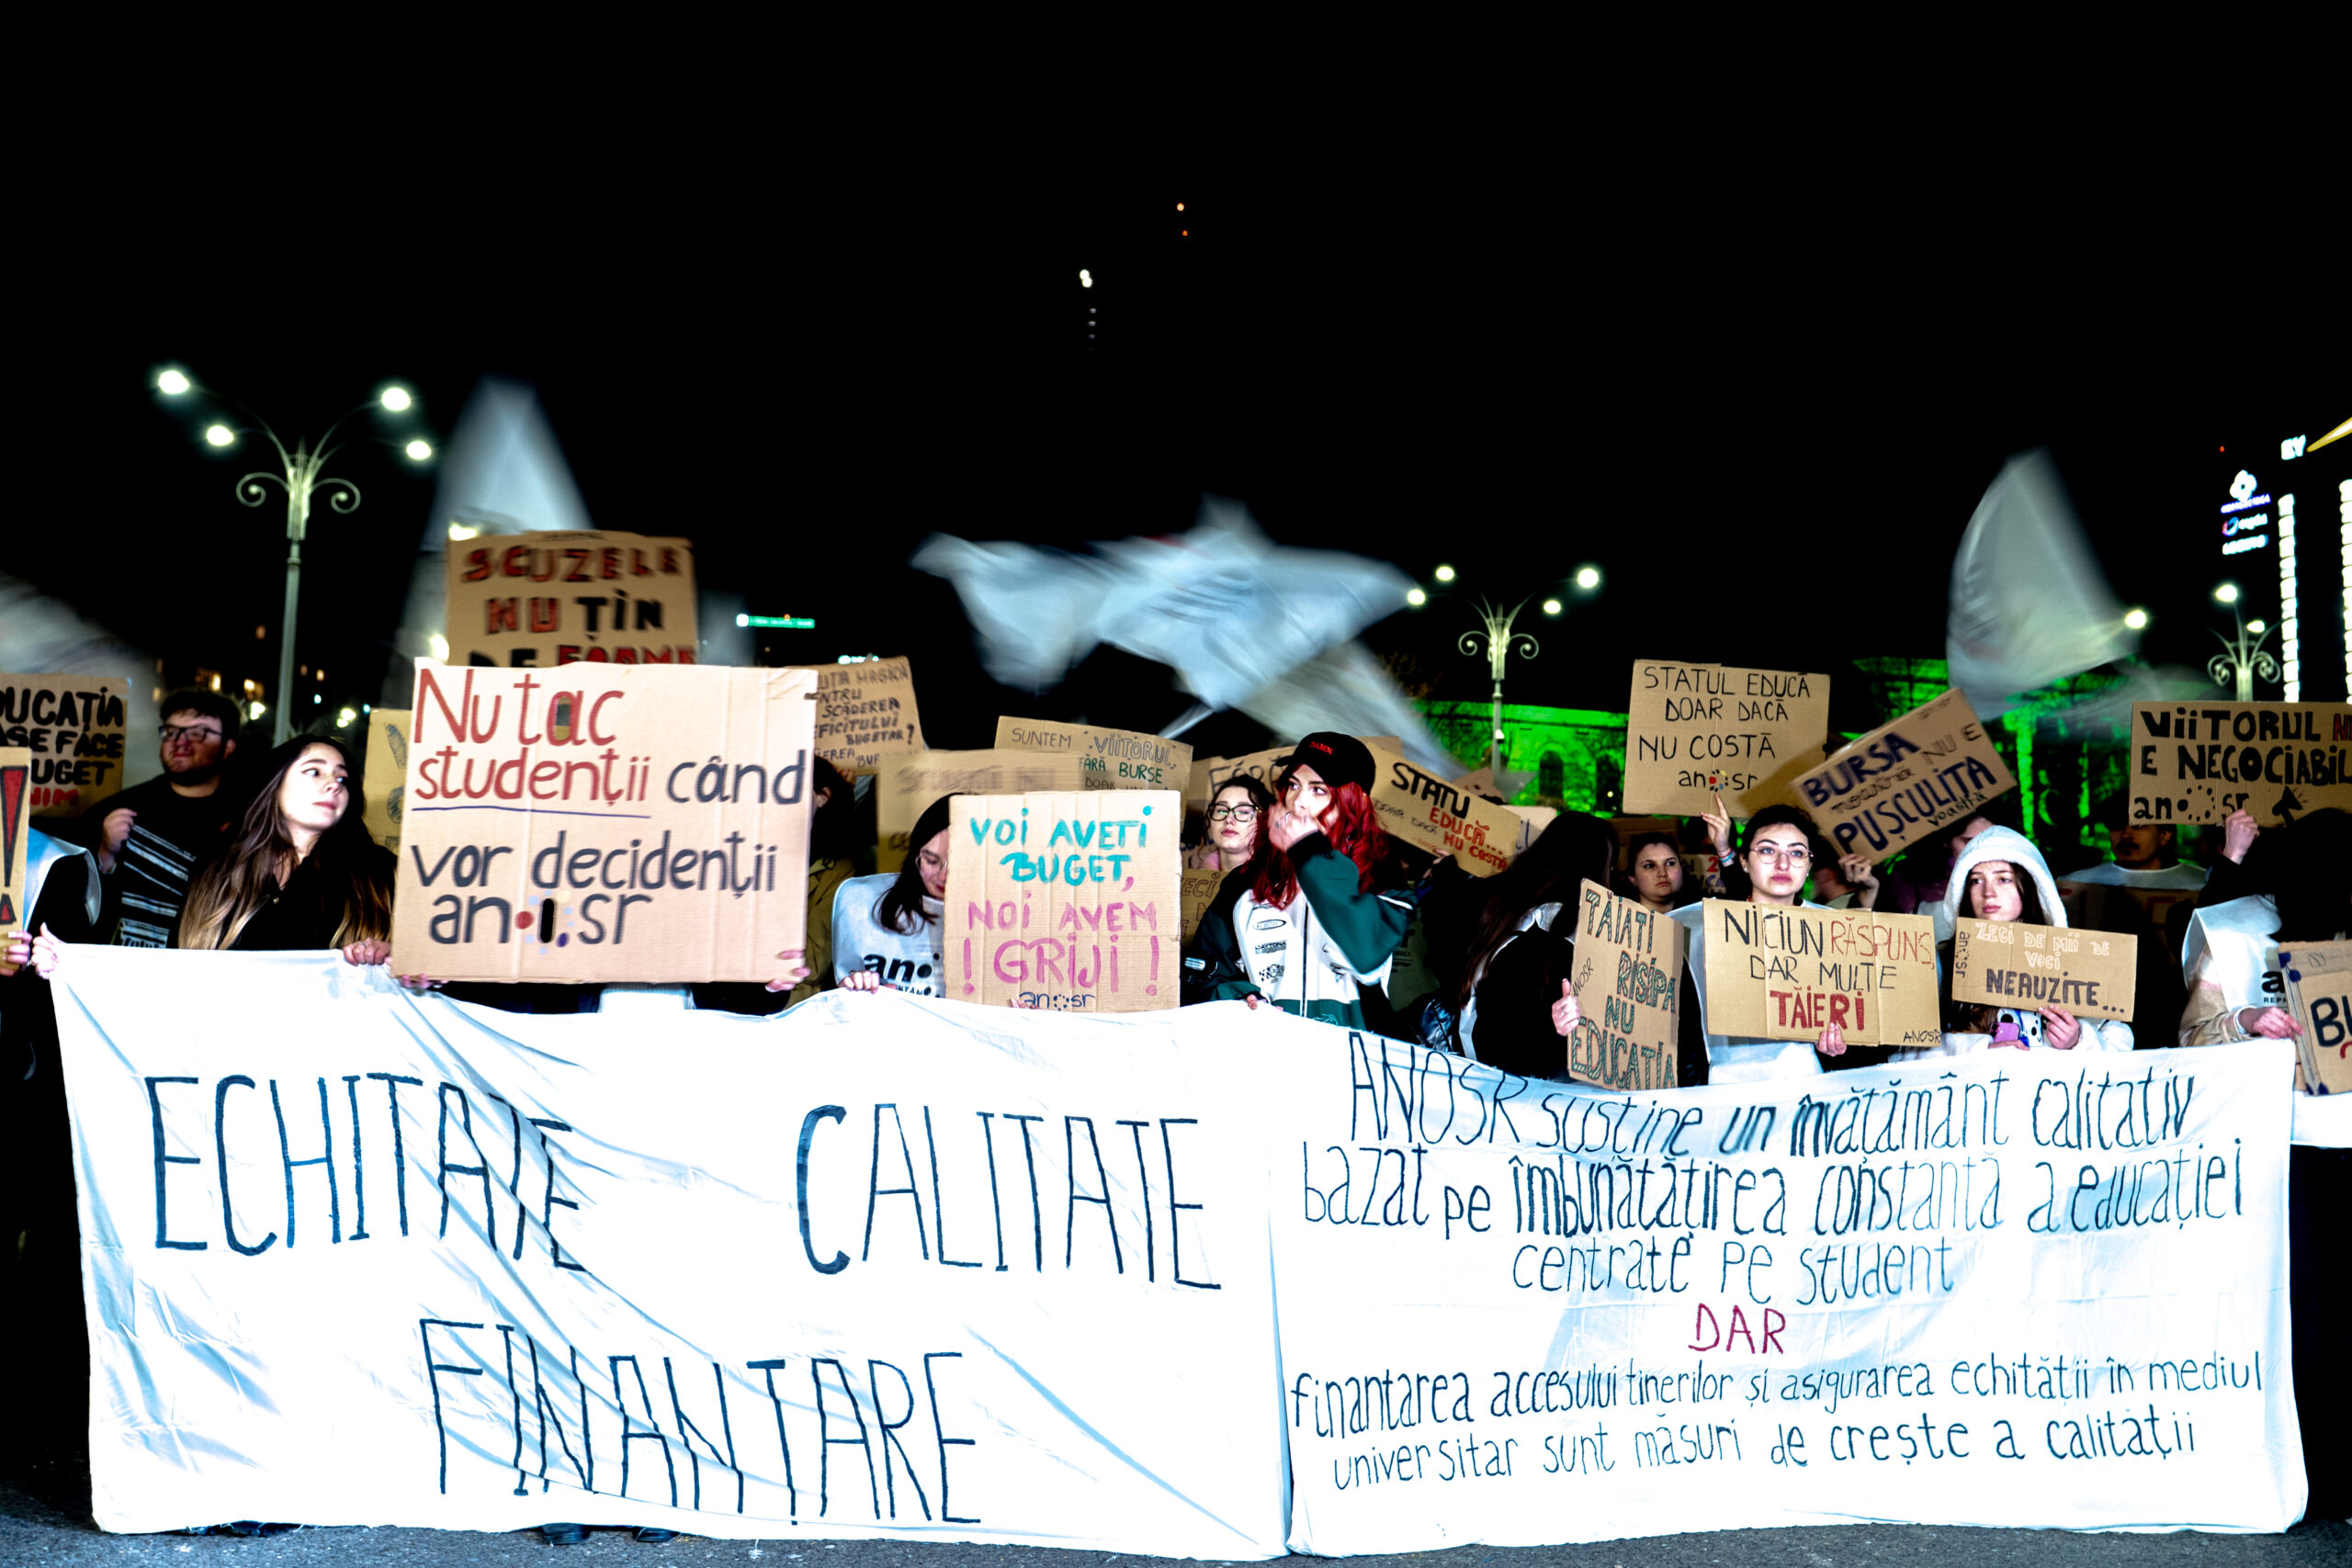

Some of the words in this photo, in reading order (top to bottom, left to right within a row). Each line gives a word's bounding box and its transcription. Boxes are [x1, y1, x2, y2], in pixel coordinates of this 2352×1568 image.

[462, 544, 687, 584] SCUZELE
[484, 597, 560, 635] NU
[1644, 666, 1736, 695] STATUL
[1747, 671, 1811, 698] EDUCĂ
[0, 685, 123, 732] UCAȚIA
[413, 668, 503, 744] Nu
[513, 673, 626, 746] tac
[814, 711, 899, 739] FICITULUI
[1665, 696, 1724, 722] DOAR
[1737, 698, 1790, 722] DACĂ
[55, 730, 124, 759] FACE
[1012, 727, 1072, 749] SUNTEM
[1638, 734, 1678, 761] NU
[1689, 732, 1776, 761] COSTĂ
[31, 759, 115, 786] UGET
[414, 745, 651, 807] studenții
[667, 750, 807, 806] când
[1118, 761, 1164, 784] BURSE
[1802, 732, 1921, 808] BURSA
[2141, 744, 2158, 776] E
[1390, 761, 1470, 819] STATU
[1443, 830, 1464, 852] NU
[411, 844, 514, 888] vor
[532, 830, 779, 899] decidenții
[1058, 900, 1159, 933] AVEM
[2024, 931, 2046, 949] DE
[2090, 941, 2110, 956] DE
[1749, 954, 1799, 984] DAR
[1819, 961, 1897, 992] MULTE
[1605, 995, 1635, 1034] NU
[1770, 985, 1865, 1032] TĂIERI
[1903, 1028, 1941, 1043] ANOSR
[1349, 1031, 1529, 1146] ANOSR
[1718, 1105, 1778, 1155] un
[2032, 1066, 2196, 1152] calitativ
[144, 1072, 589, 1274] ECHITATE
[1303, 1141, 1430, 1227] bazat
[1443, 1183, 1492, 1240] pe
[2027, 1161, 2062, 1234] a
[2071, 1137, 2245, 1232] educației
[796, 1102, 1223, 1290] CALITATE
[1512, 1235, 1690, 1293] centrate
[1796, 1235, 1955, 1306] student
[1688, 1303, 1787, 1354] DAR
[1490, 1362, 1620, 1419] accesului
[1745, 1368, 1770, 1409] și
[1780, 1361, 1937, 1415] asigurarea
[2106, 1355, 2134, 1394] în
[2149, 1349, 2262, 1392] mediul
[1543, 1421, 1617, 1475] sunt
[1634, 1412, 1742, 1469] măsuri
[1770, 1423, 1809, 1468] de
[1829, 1412, 1972, 1466] crește
[1993, 1419, 2027, 1461] a
